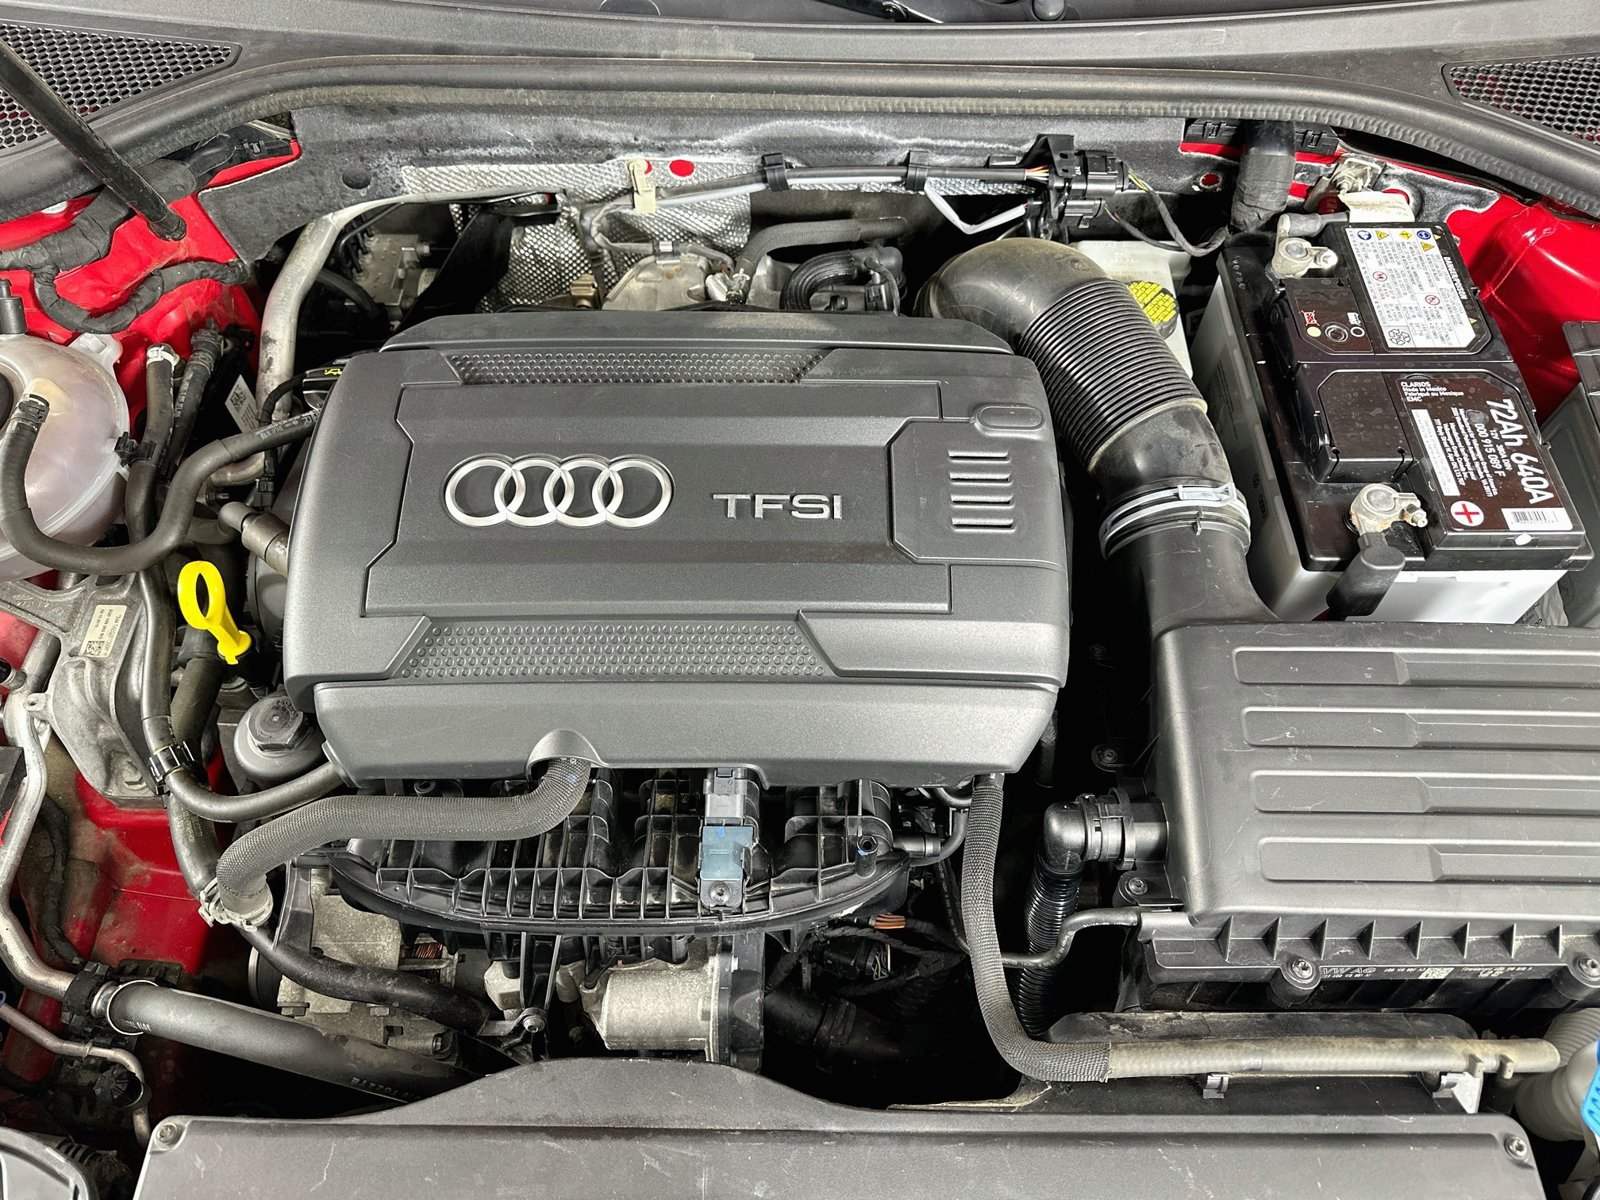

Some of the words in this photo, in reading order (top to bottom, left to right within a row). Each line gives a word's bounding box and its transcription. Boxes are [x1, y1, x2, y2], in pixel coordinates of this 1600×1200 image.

[1479, 438, 1495, 453] 915
[1486, 398, 1528, 447] 72Ah
[1510, 452, 1555, 504] 640A
[1486, 454, 1502, 468] 089
[713, 494, 842, 519] TFSI
